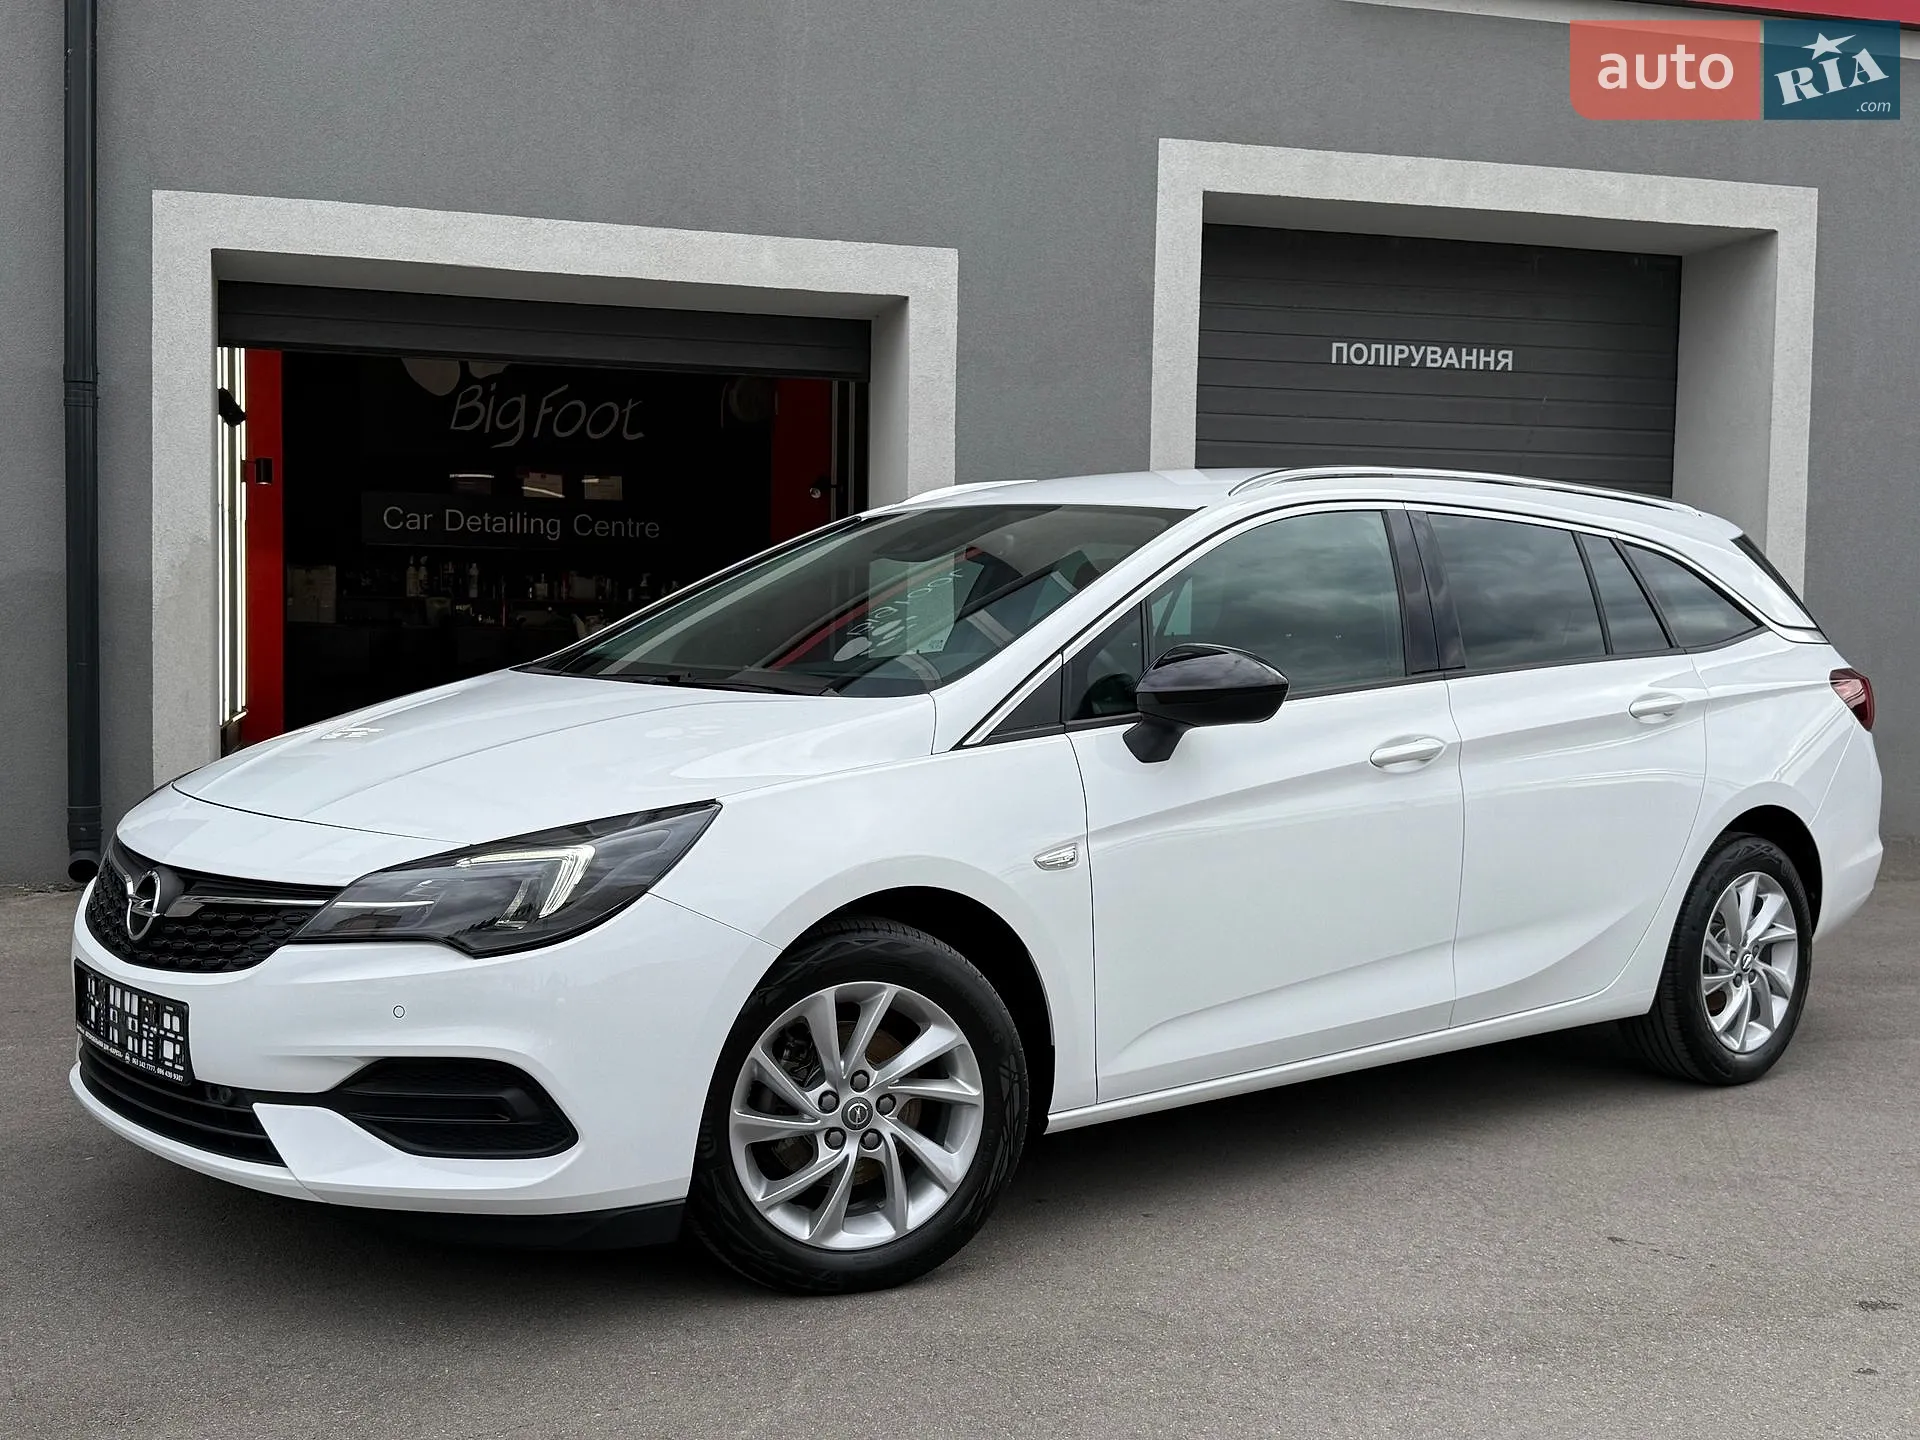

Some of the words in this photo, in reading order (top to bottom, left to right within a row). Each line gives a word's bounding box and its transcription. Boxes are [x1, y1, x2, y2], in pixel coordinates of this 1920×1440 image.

[1331, 342, 1514, 372] ПОЛІРУВАННЯ
[383, 506, 433, 531] Car
[445, 508, 562, 541] Detailing
[573, 513, 660, 539] Centre
